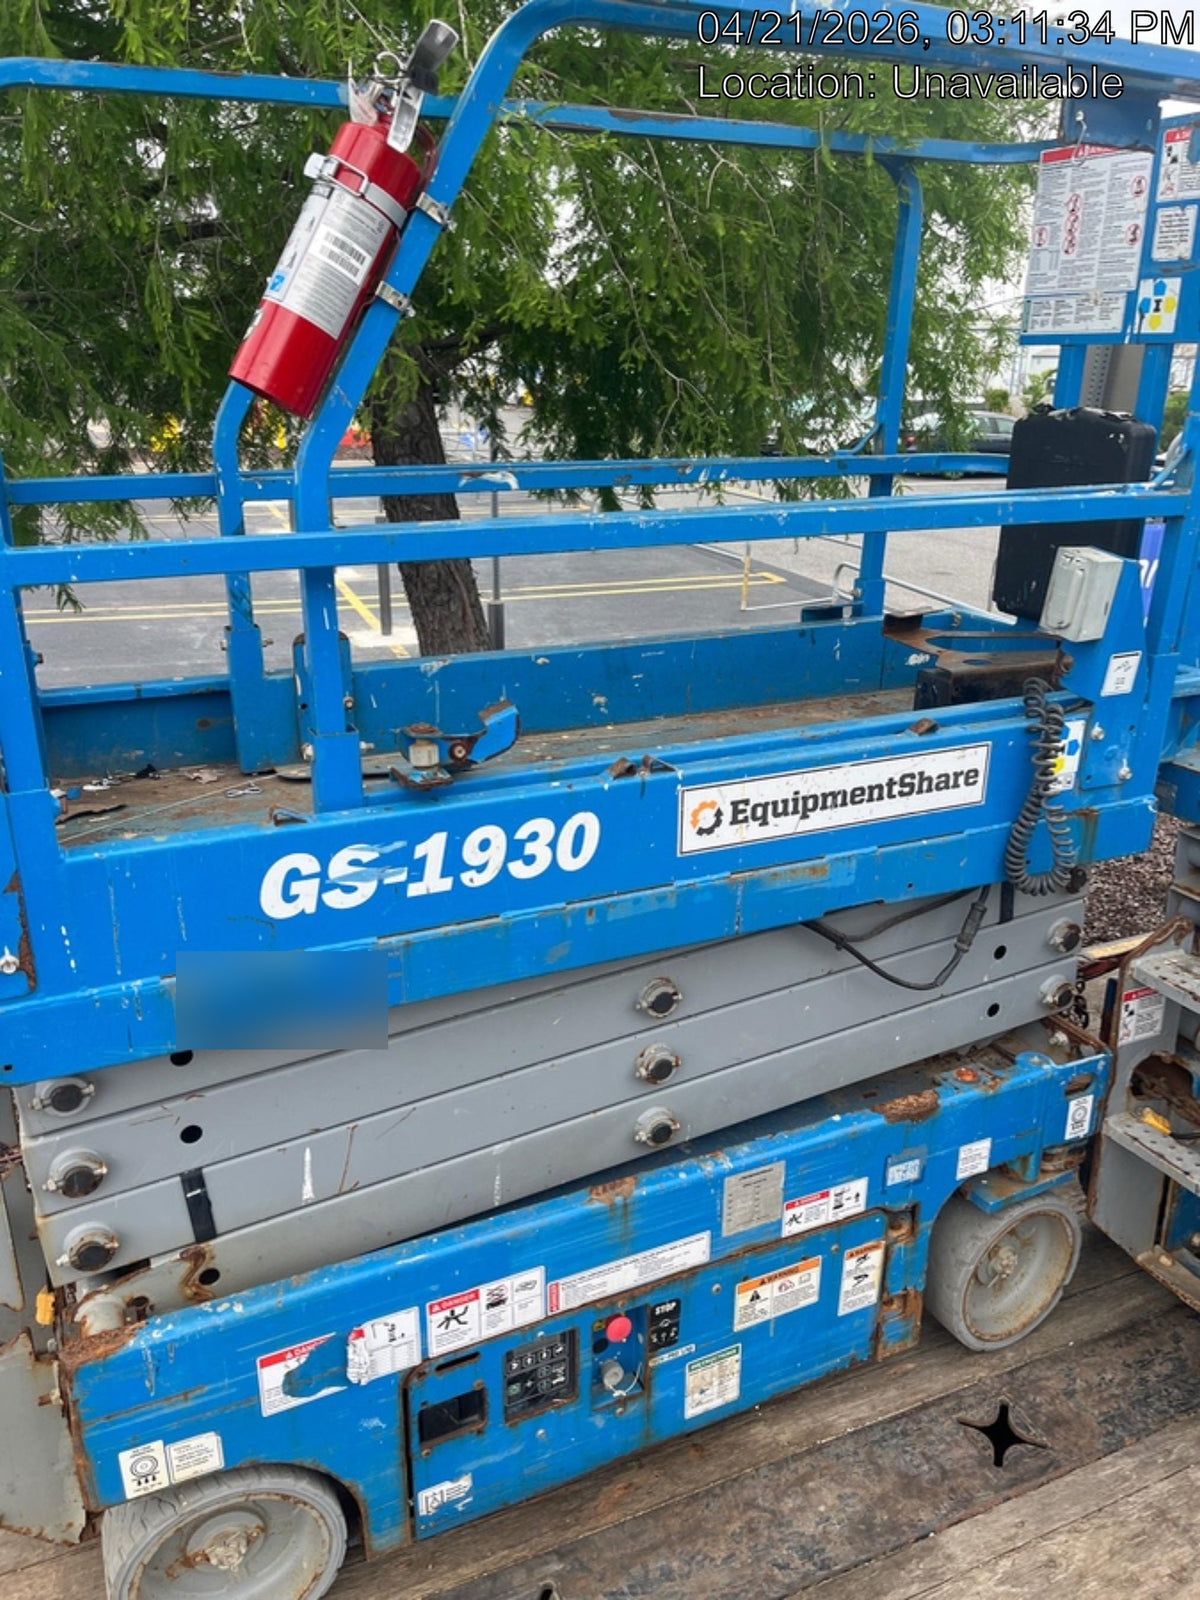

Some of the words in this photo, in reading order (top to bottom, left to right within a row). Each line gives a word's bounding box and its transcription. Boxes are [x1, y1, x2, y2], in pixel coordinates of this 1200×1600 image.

[729, 767, 979, 827] EquipmentShare
[259, 811, 601, 920] GS-1930
[442, 1292, 476, 1309] DANGER
[655, 1301, 677, 1316] STOP
